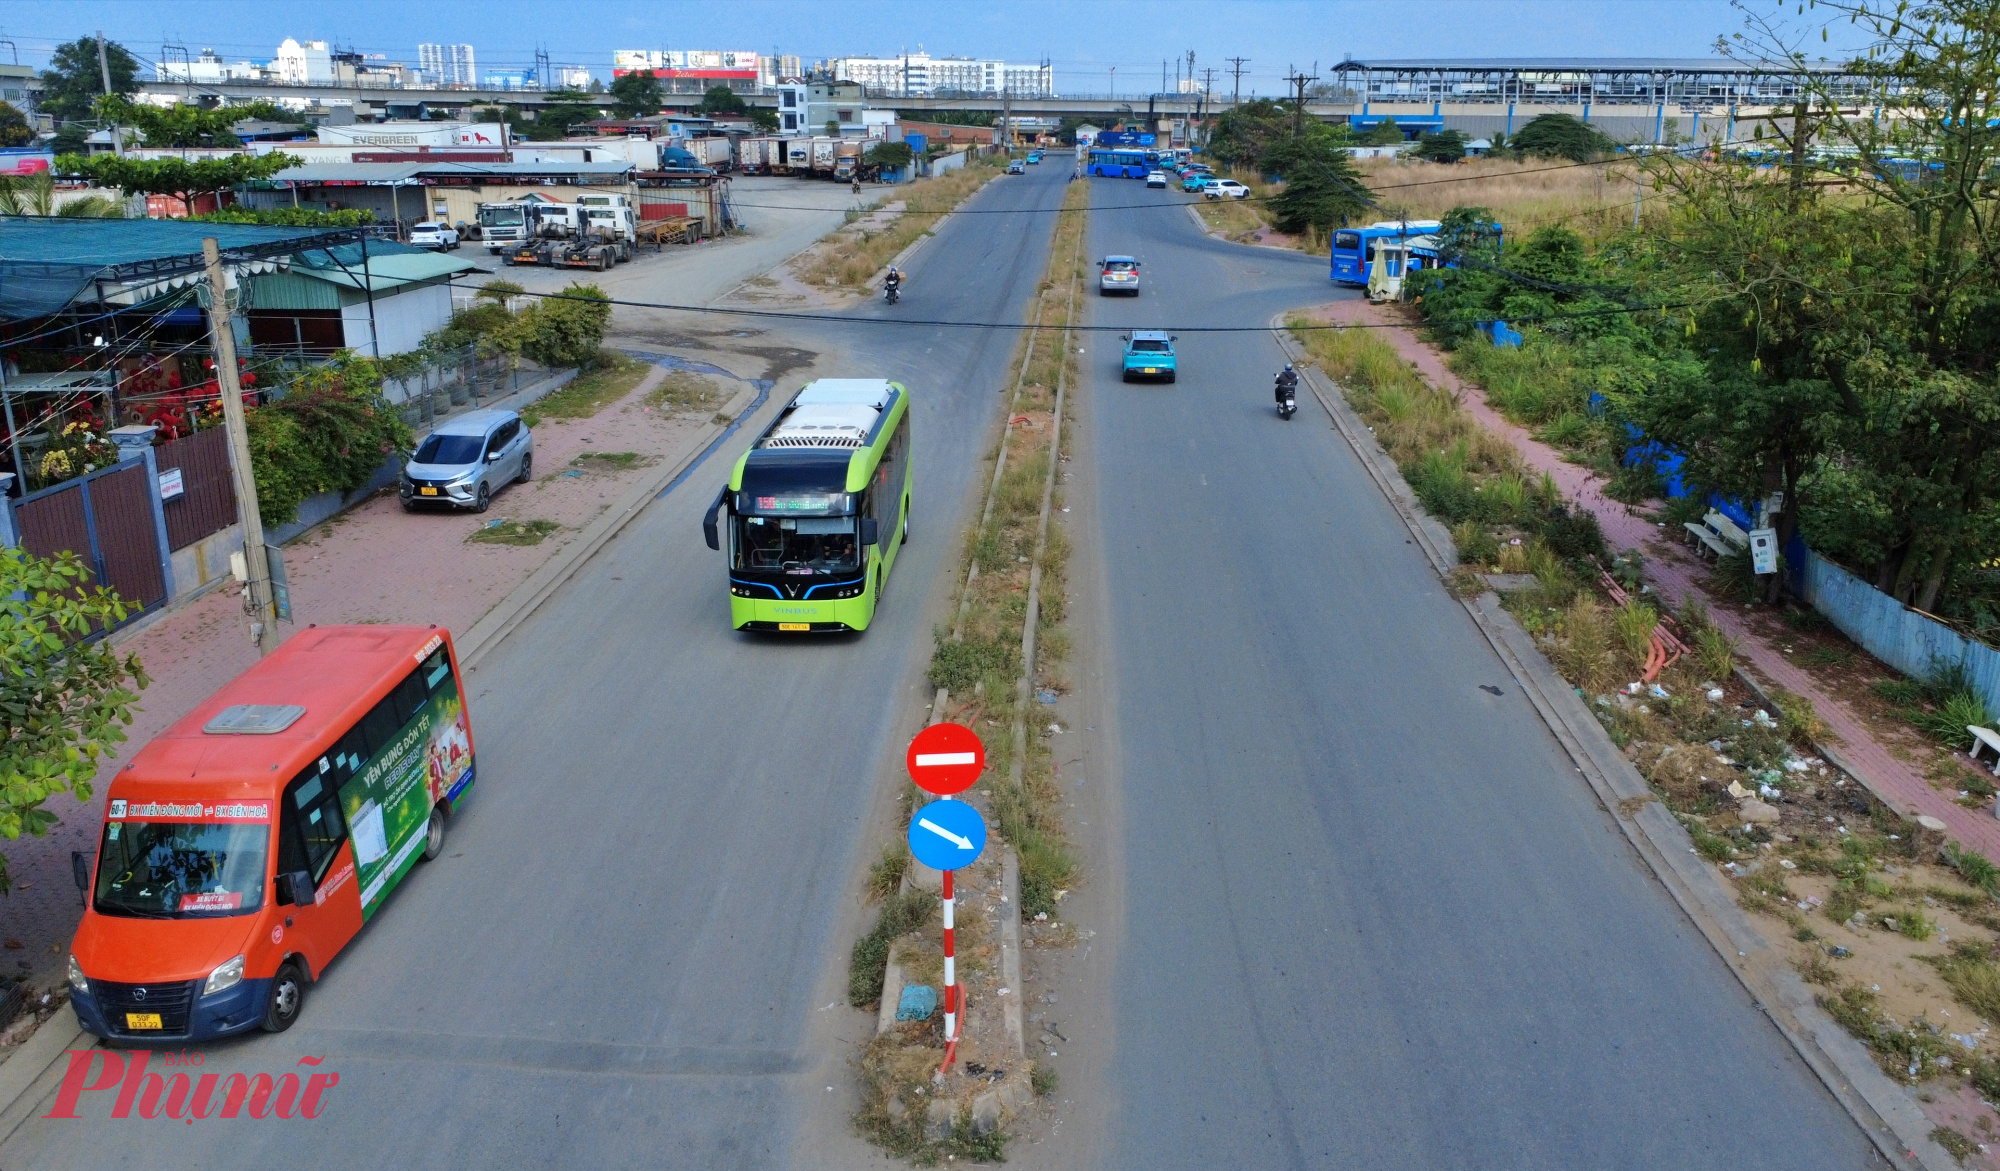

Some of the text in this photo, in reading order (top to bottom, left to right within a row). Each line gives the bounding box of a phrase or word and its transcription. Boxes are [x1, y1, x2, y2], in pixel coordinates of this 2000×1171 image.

[352, 135, 419, 145] EVERGREEN
[774, 607, 818, 615] VINBUS
[363, 763, 381, 788] YÊN
[380, 742, 404, 772] BỤNG
[403, 728, 419, 750] ĐÓN
[417, 714, 430, 733] TẾT
[111, 804, 126, 815] 60-7
[129, 804, 140, 816] BX
[161, 802, 185, 816] ĐÔNG
[184, 803, 203, 817] MỚI
[215, 805, 228, 817] BX
[228, 804, 248, 817] BIÊN
